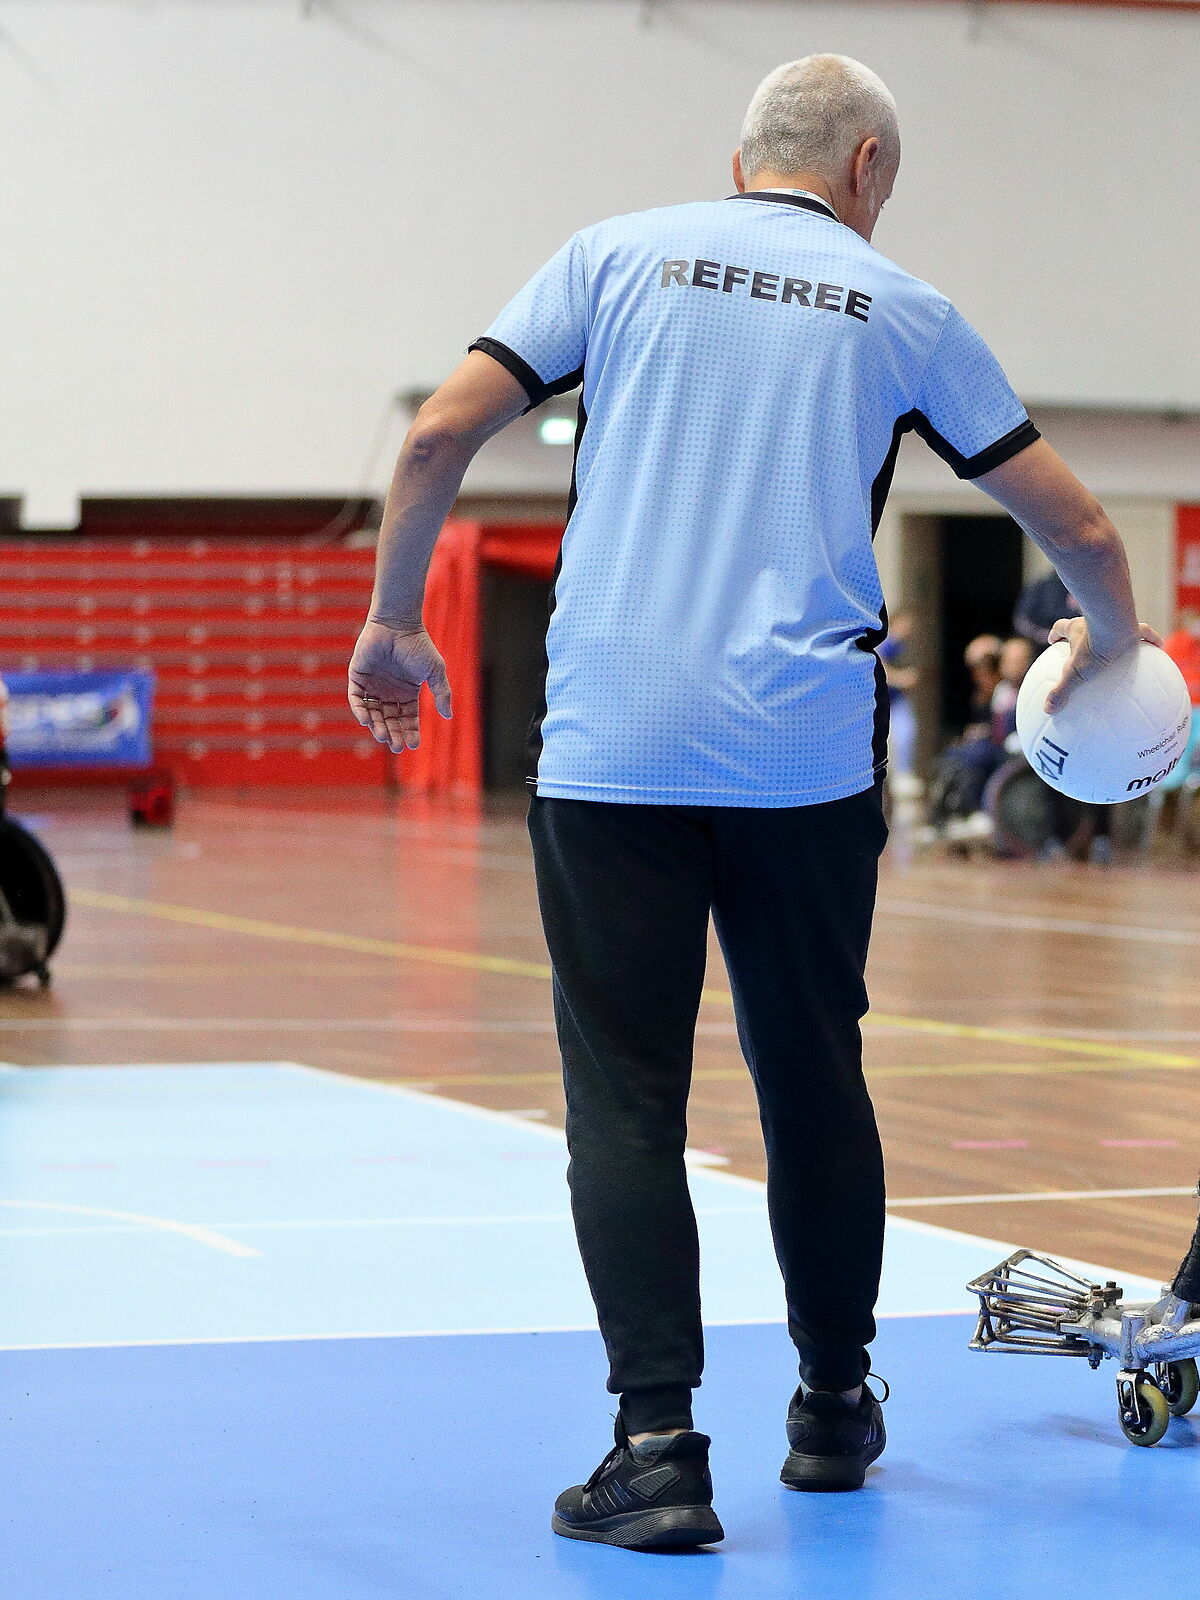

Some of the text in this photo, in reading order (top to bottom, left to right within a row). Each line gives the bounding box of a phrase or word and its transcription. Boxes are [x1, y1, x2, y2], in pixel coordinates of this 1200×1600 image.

[661, 259, 873, 323] REFEREE
[1035, 736, 1069, 780] ITA
[1137, 731, 1176, 759] Wheelchair
